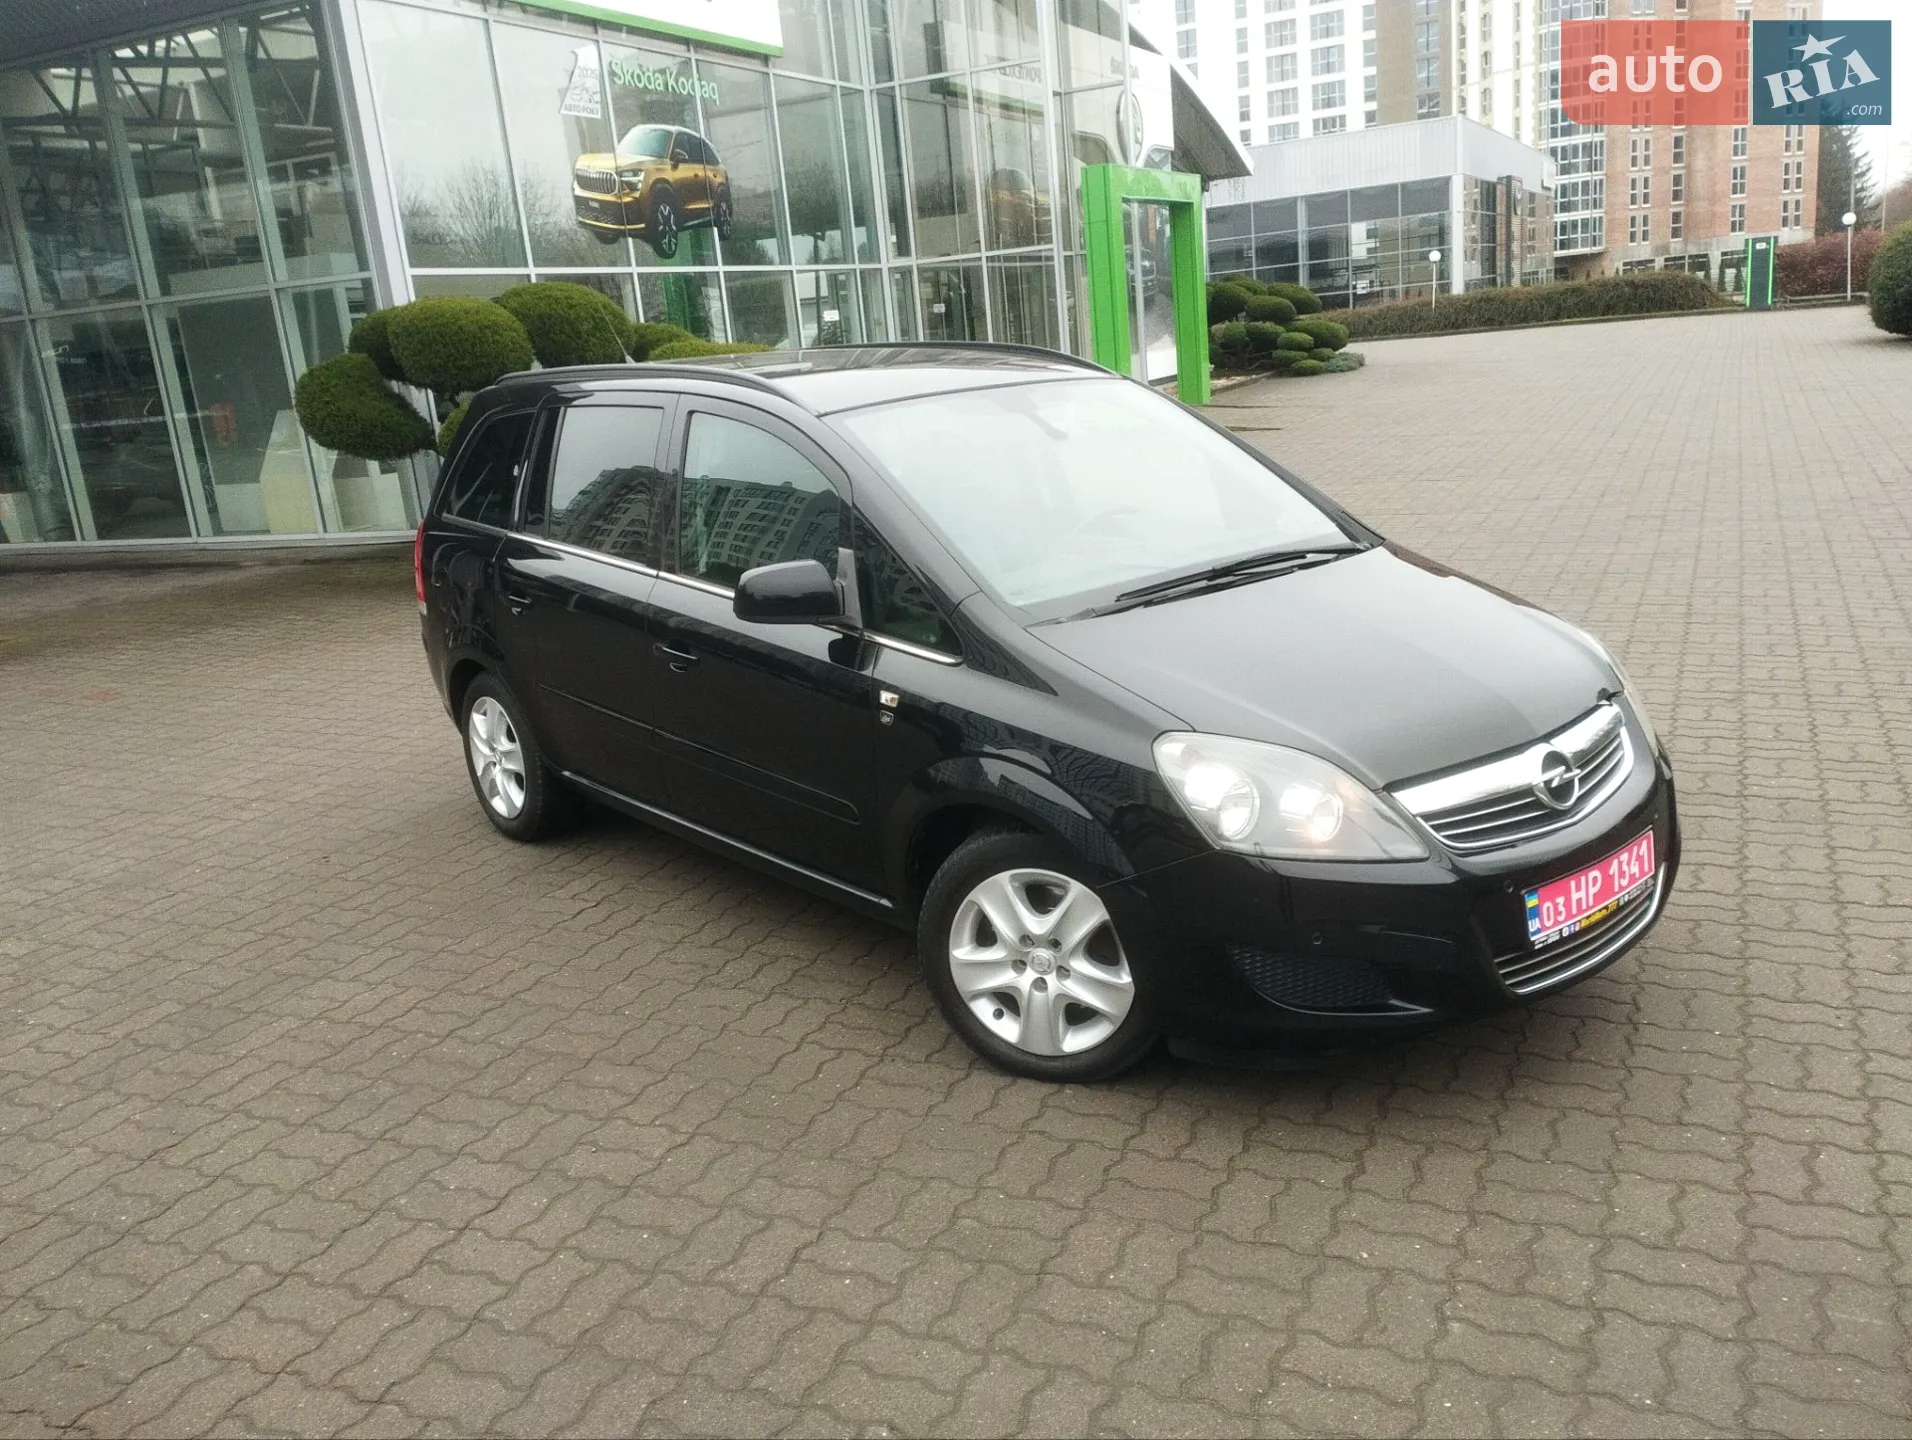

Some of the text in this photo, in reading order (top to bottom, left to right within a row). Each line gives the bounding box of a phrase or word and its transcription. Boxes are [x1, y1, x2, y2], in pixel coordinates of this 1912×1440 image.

[1542, 897, 1566, 927] 03
[1570, 870, 1602, 915] HP
[1609, 839, 1649, 893] 1341
[1528, 918, 1541, 932] UA
